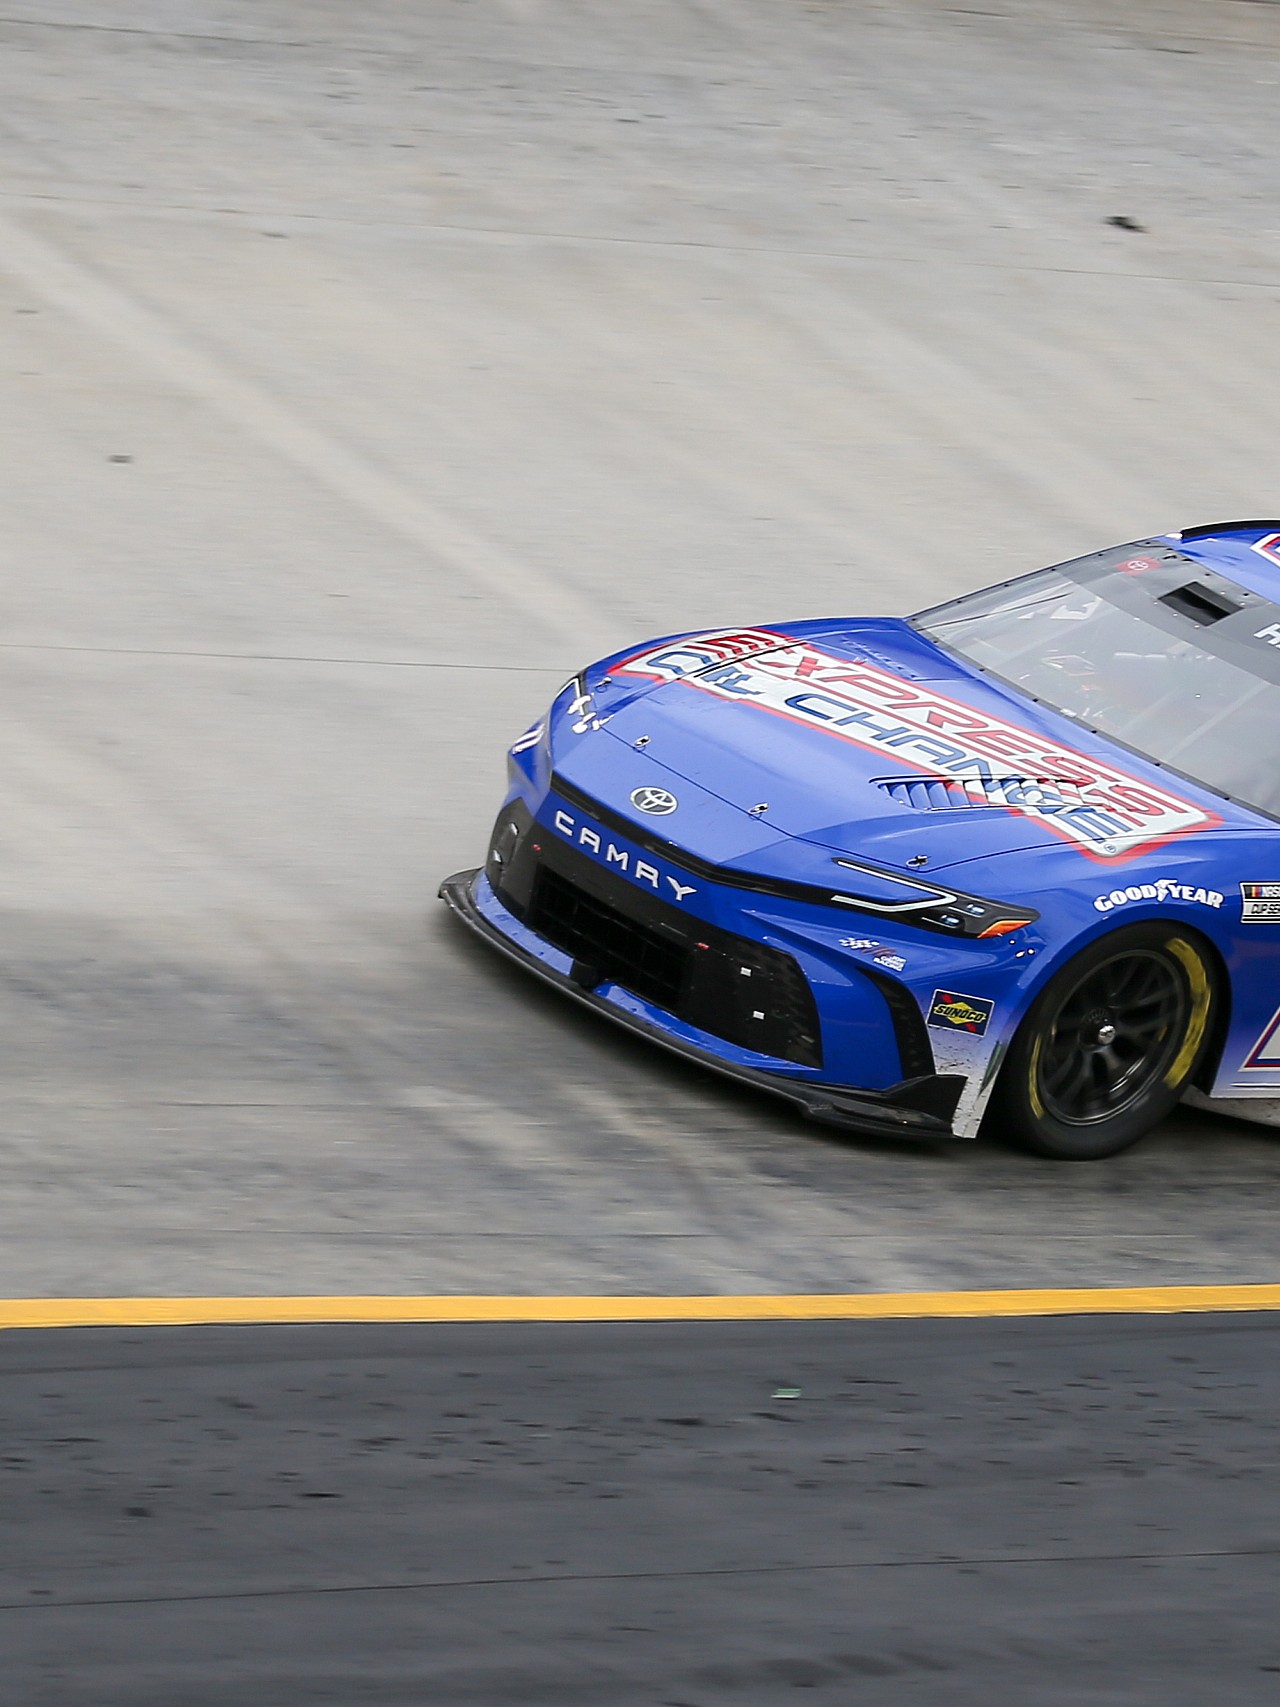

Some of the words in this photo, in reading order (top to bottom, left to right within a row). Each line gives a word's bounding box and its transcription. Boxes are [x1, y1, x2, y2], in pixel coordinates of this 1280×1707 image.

[647, 651, 766, 696] OIL
[785, 693, 1134, 844] CHANGE
[682, 633, 1188, 827] EXPRESS
[555, 810, 698, 901] CAMRY
[1093, 879, 1224, 912] GOODYEAR
[1251, 904, 1268, 914] CUP
[935, 1005, 987, 1022] SUNOCO
